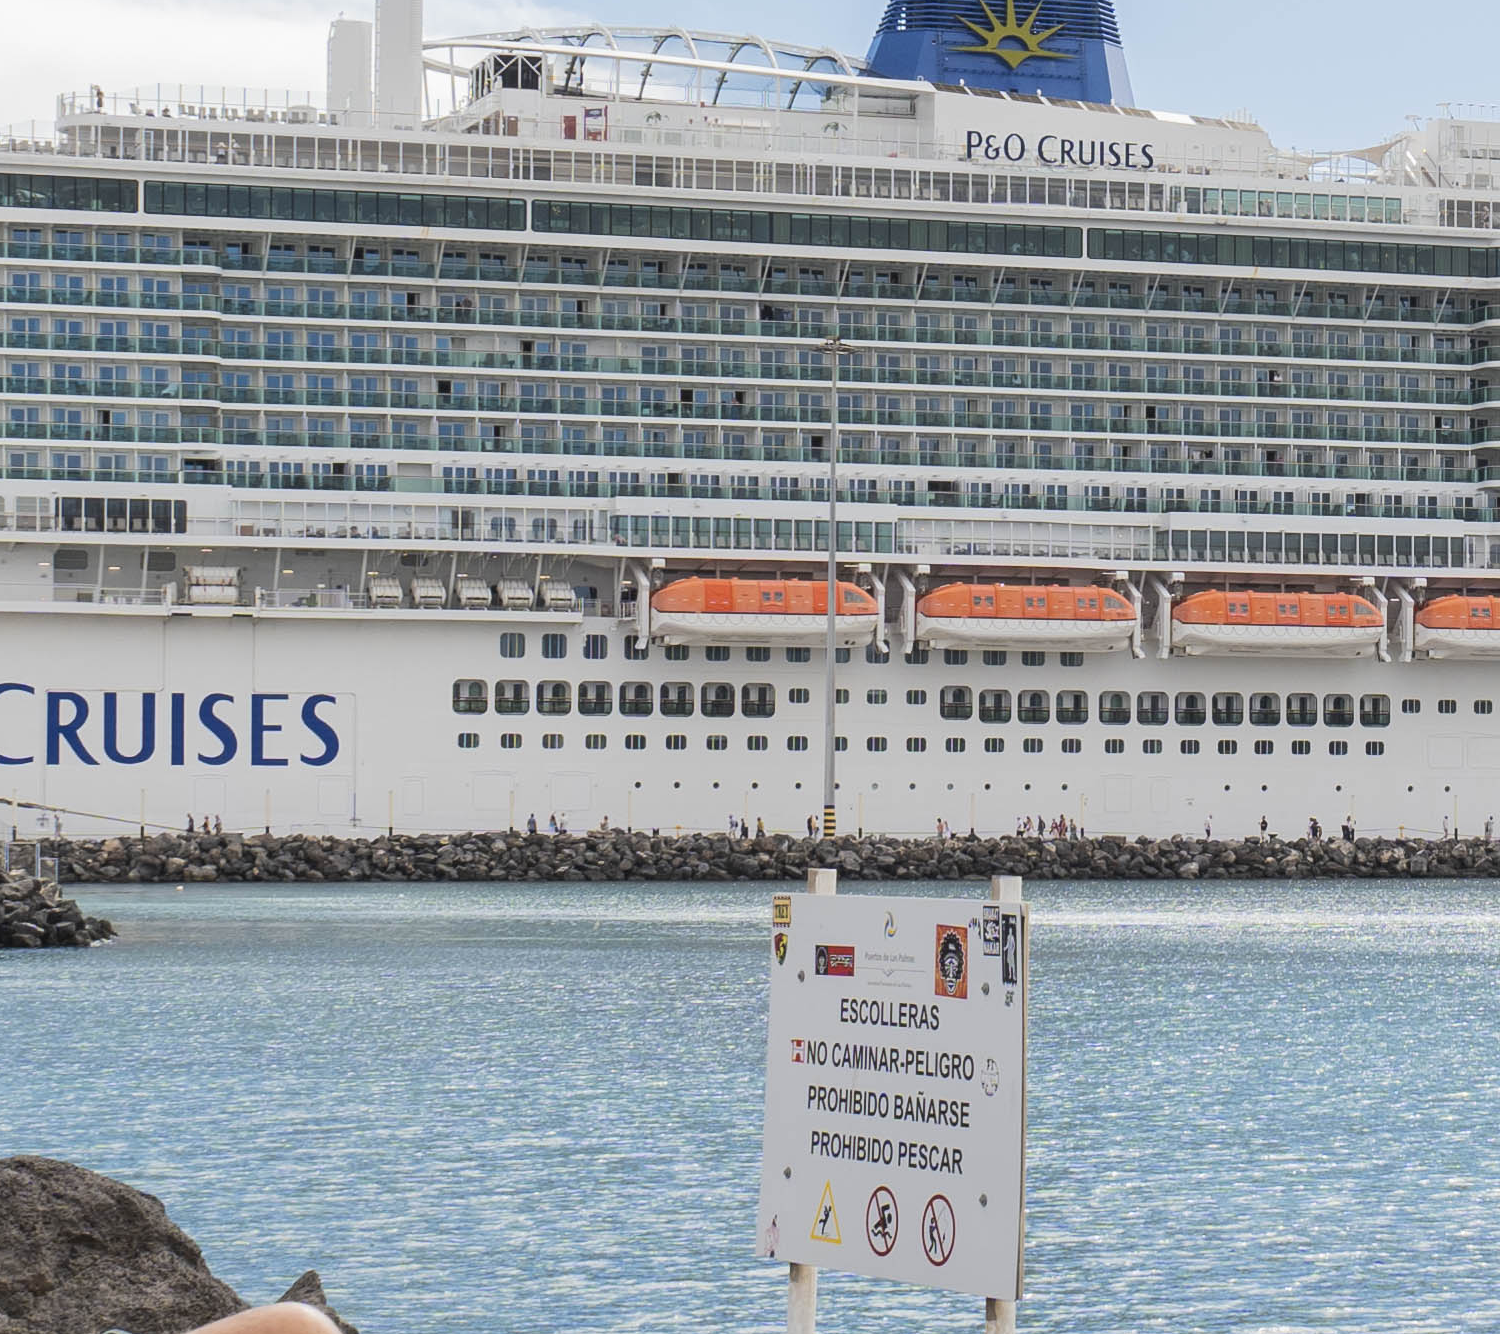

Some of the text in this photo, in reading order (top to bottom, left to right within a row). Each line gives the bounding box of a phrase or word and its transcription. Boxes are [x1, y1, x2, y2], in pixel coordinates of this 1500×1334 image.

[966, 130, 1155, 169] P&O CRUISES
[840, 998, 940, 1031] ESCOLLERAS
[806, 1040, 828, 1066] NO
[807, 1085, 970, 1128] PROHIBIDO BAÑARSE
[810, 1130, 963, 1175] PROHIBIDO PESCAR
